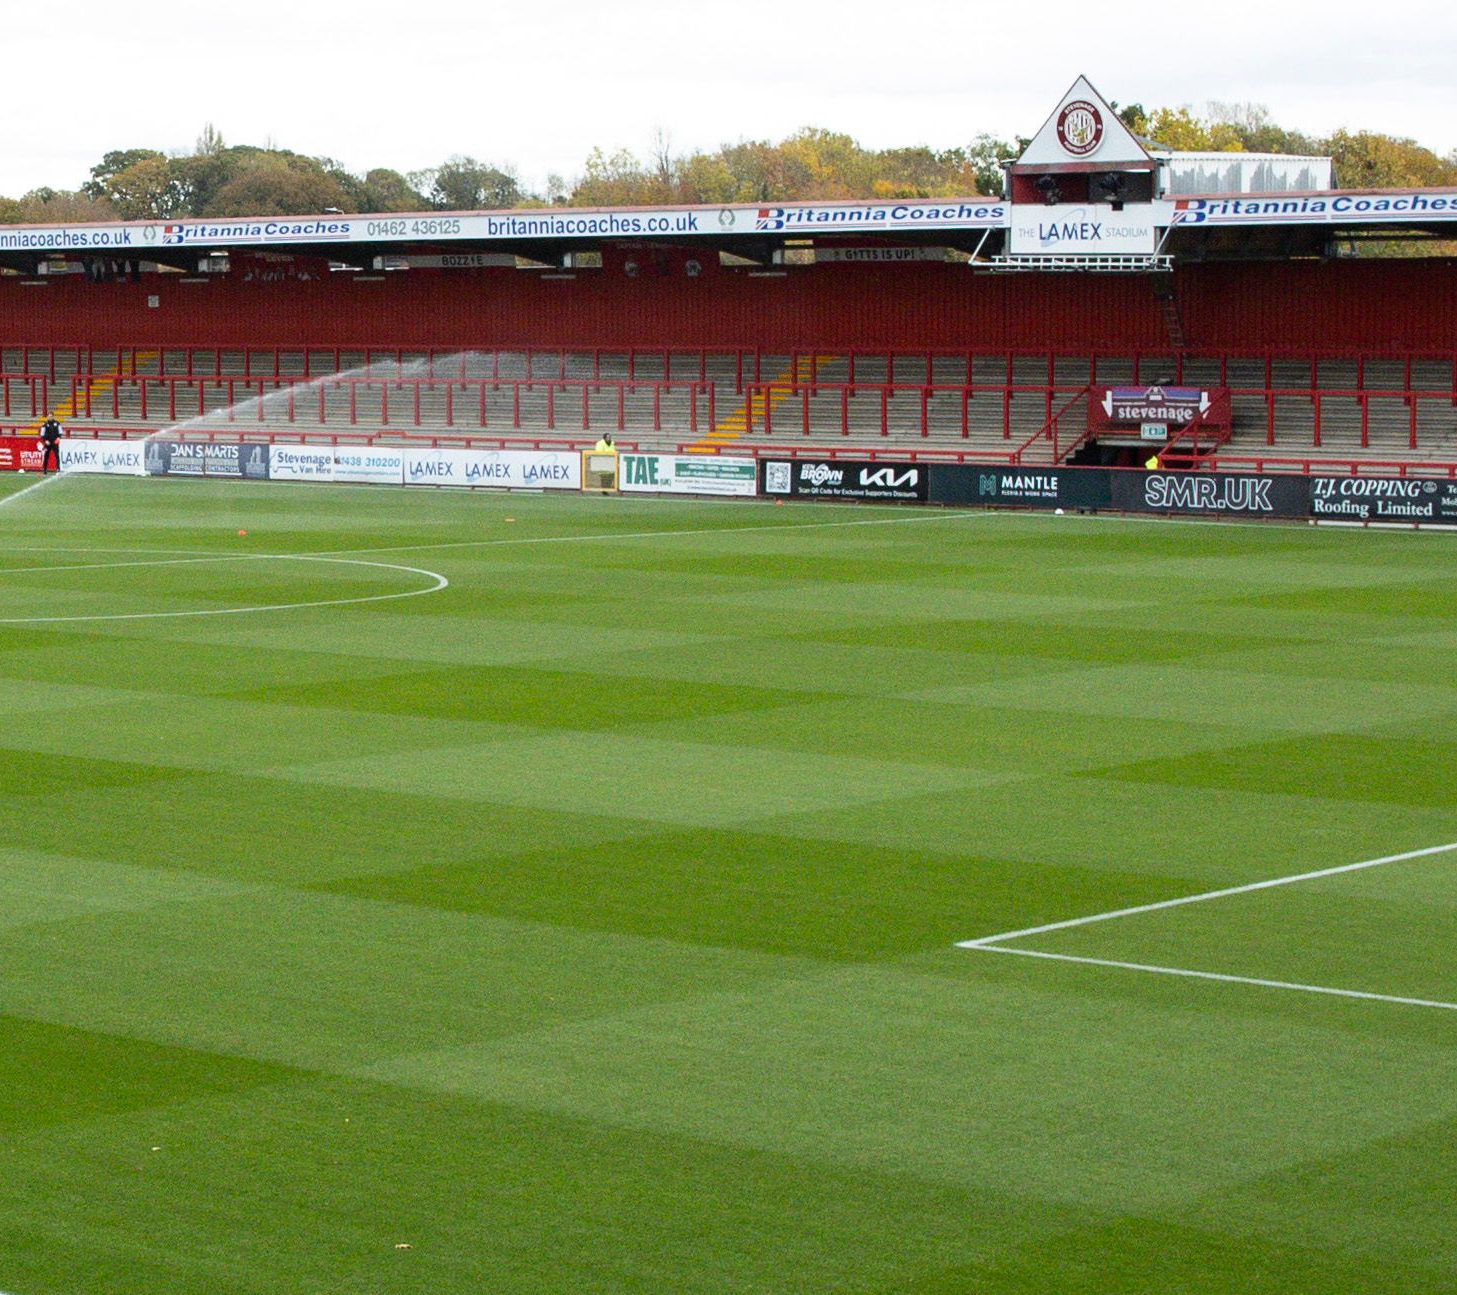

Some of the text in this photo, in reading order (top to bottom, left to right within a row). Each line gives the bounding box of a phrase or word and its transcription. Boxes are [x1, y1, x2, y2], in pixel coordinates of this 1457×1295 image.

[755, 204, 1004, 230] Britannia Coaches
[1174, 199, 1326, 223] Britannia
[1019, 223, 1148, 241] THE LAMEX STADIUM
[1118, 406, 1193, 423] stevenage
[61, 451, 140, 466] LAMEX LAMEX
[171, 444, 239, 459] DAN SMARTS
[277, 451, 332, 467] Stevenage
[365, 457, 401, 468] 310200
[624, 456, 660, 485] TAE
[1001, 475, 1058, 490] MANTLE
[1314, 479, 1421, 497] T.J. COPPING
[1145, 474, 1272, 512] SMR.UK
[1314, 499, 1370, 518] Roofing
[1377, 500, 1433, 517] Limited
